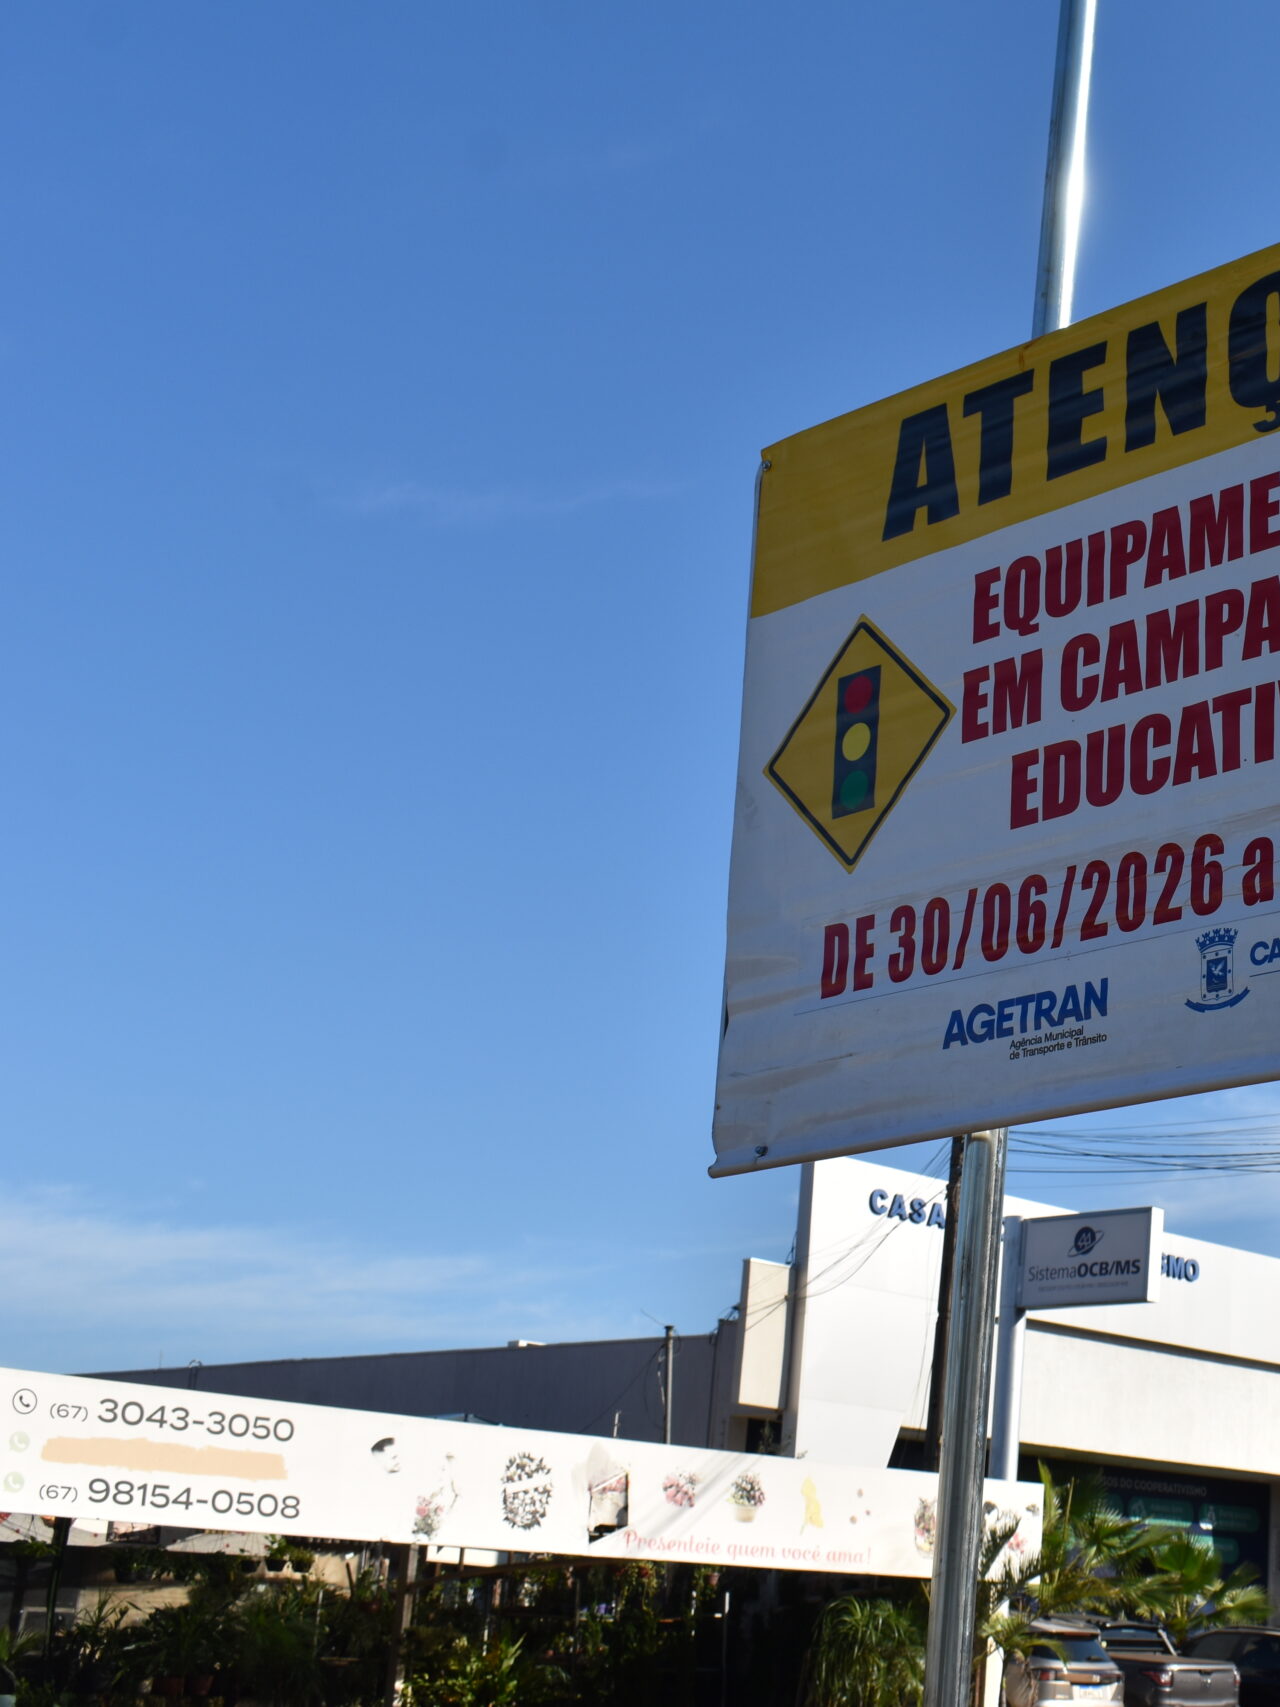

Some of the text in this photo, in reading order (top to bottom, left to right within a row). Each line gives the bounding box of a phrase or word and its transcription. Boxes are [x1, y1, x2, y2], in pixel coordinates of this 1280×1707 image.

[961, 648, 1043, 745] EM
[820, 913, 876, 1000] DE
[887, 832, 1225, 985] 30/06/2026
[1241, 836, 1275, 907] a
[942, 976, 1109, 1051] AGETRAN
[1009, 1025, 1084, 1053] Agência Municipal
[1009, 1032, 1108, 1061] de Transporte e Trânsito
[868, 1188, 946, 1230] CASA
[1027, 1258, 1141, 1282] SistemaOCB/MS
[49, 1398, 295, 1443] (67) 3043-3050
[38, 1477, 301, 1520] (67) 98154-0508
[622, 1529, 721, 1556] Presenteie
[726, 1540, 776, 1561] quem
[825, 1547, 873, 1565] ama!
